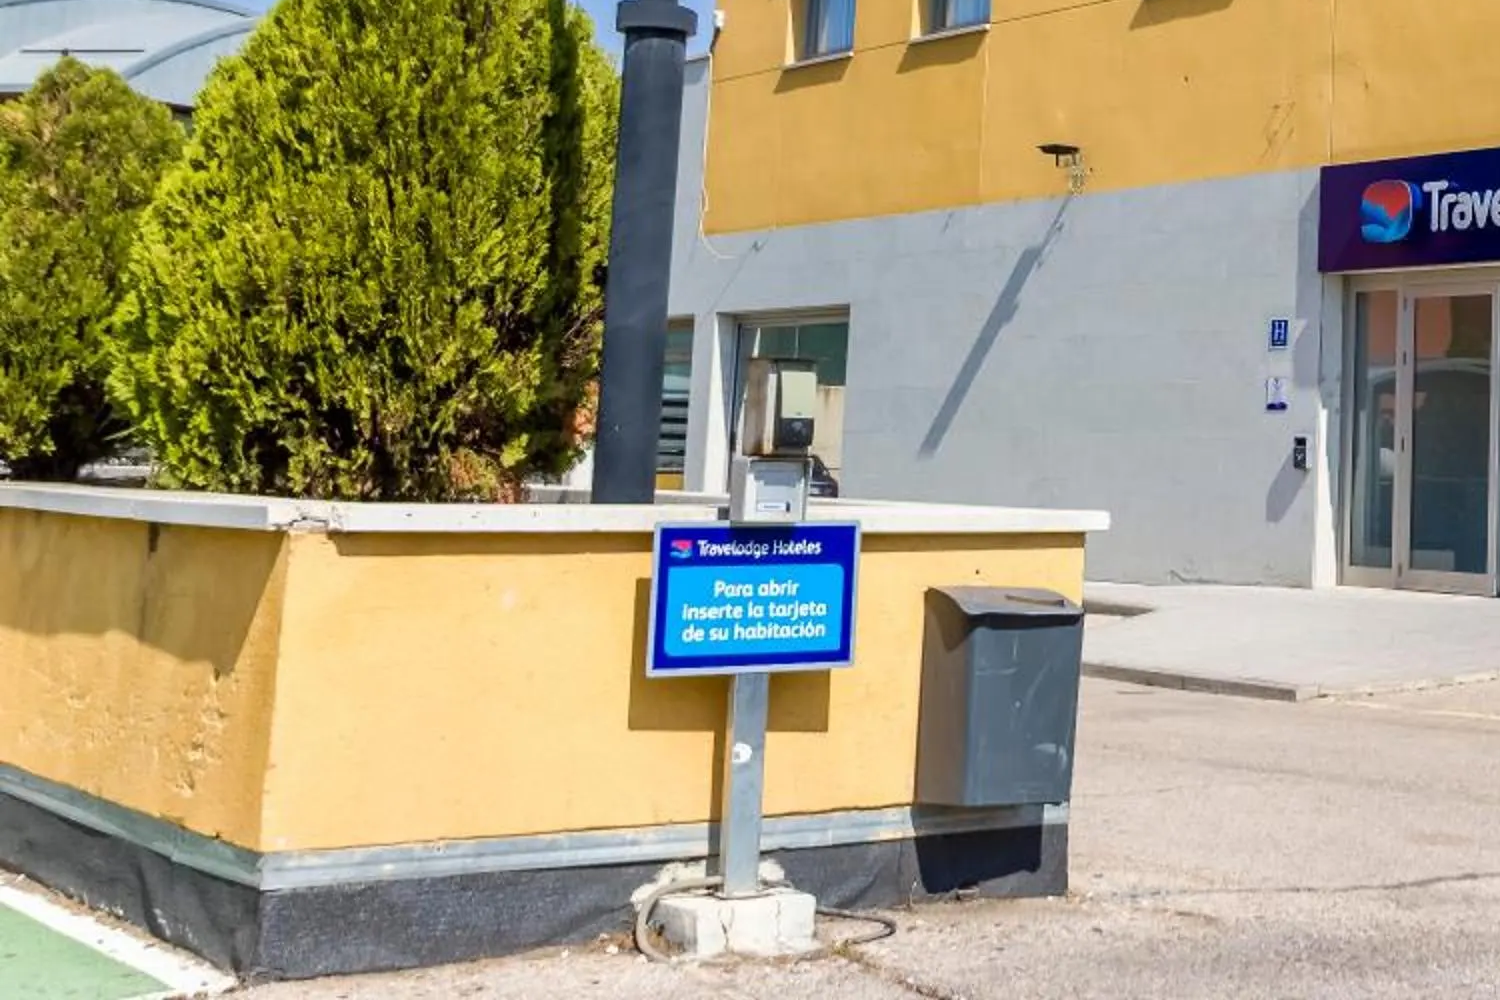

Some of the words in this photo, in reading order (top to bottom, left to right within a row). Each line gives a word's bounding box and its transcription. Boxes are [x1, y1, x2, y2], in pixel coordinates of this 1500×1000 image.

[697, 540, 769, 558] Travelodge
[772, 538, 822, 555] Hoteles
[714, 579, 754, 598] Para
[757, 578, 800, 597] abrir
[747, 600, 764, 618] la
[768, 601, 827, 621] tarjeta
[681, 623, 705, 642] de
[709, 627, 729, 642] su
[733, 620, 826, 641] habitación
